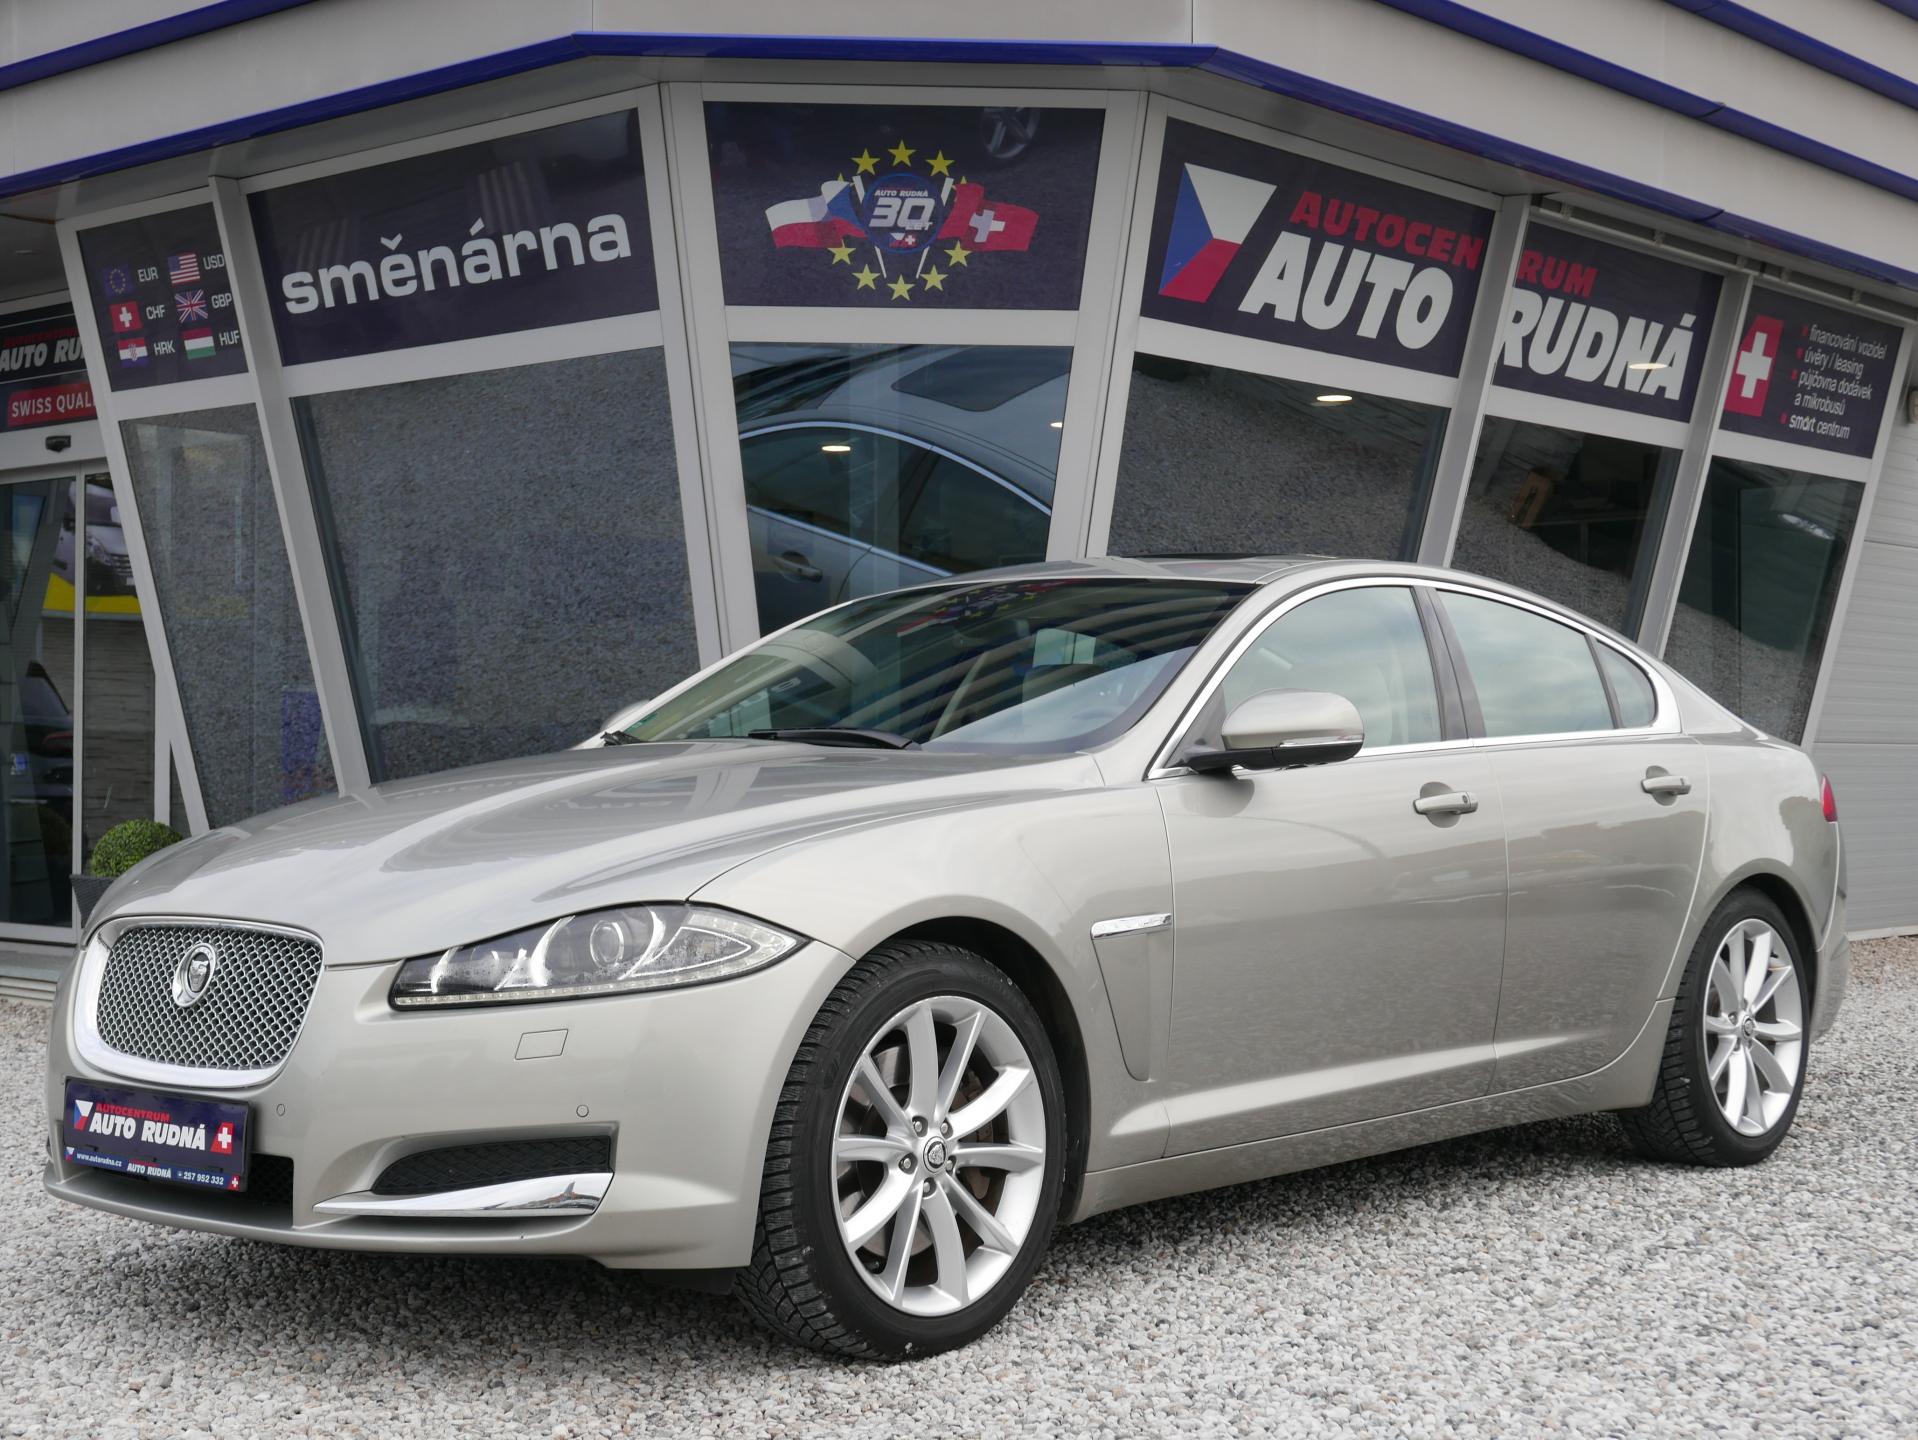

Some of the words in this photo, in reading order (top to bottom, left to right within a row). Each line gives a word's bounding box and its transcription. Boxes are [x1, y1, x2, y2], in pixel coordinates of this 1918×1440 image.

[869, 197, 935, 228] 30
[203, 254, 225, 270] USD
[282, 213, 632, 315] směnárna
[138, 266, 159, 282] EUR
[211, 292, 232, 309] GBP
[146, 304, 166, 320] CHF
[1238, 230, 1453, 350] AUTO
[1496, 287, 1697, 401] RUDNÁ
[218, 330, 240, 346] HUF
[1809, 324, 1859, 352] financování
[0, 342, 48, 372] AUTO
[54, 337, 86, 363] RU
[153, 340, 176, 356] HRK
[1834, 352, 1864, 380] leasing
[1837, 378, 1873, 400] dodávek
[12, 397, 52, 417] SWISS
[56, 390, 95, 413] QUAL
[1794, 393, 1802, 406] a
[1816, 421, 1851, 439] centrum
[96, 1103, 170, 1122] AUTOCENTRUM
[89, 1112, 136, 1139] AUTO
[141, 1120, 206, 1151] RUDNÁ
[127, 1163, 146, 1174] AUTO
[147, 1166, 172, 1179] RUDNÁ
[183, 1171, 196, 1181] 257
[196, 1173, 210, 1183] 952
[210, 1175, 225, 1185] 332
